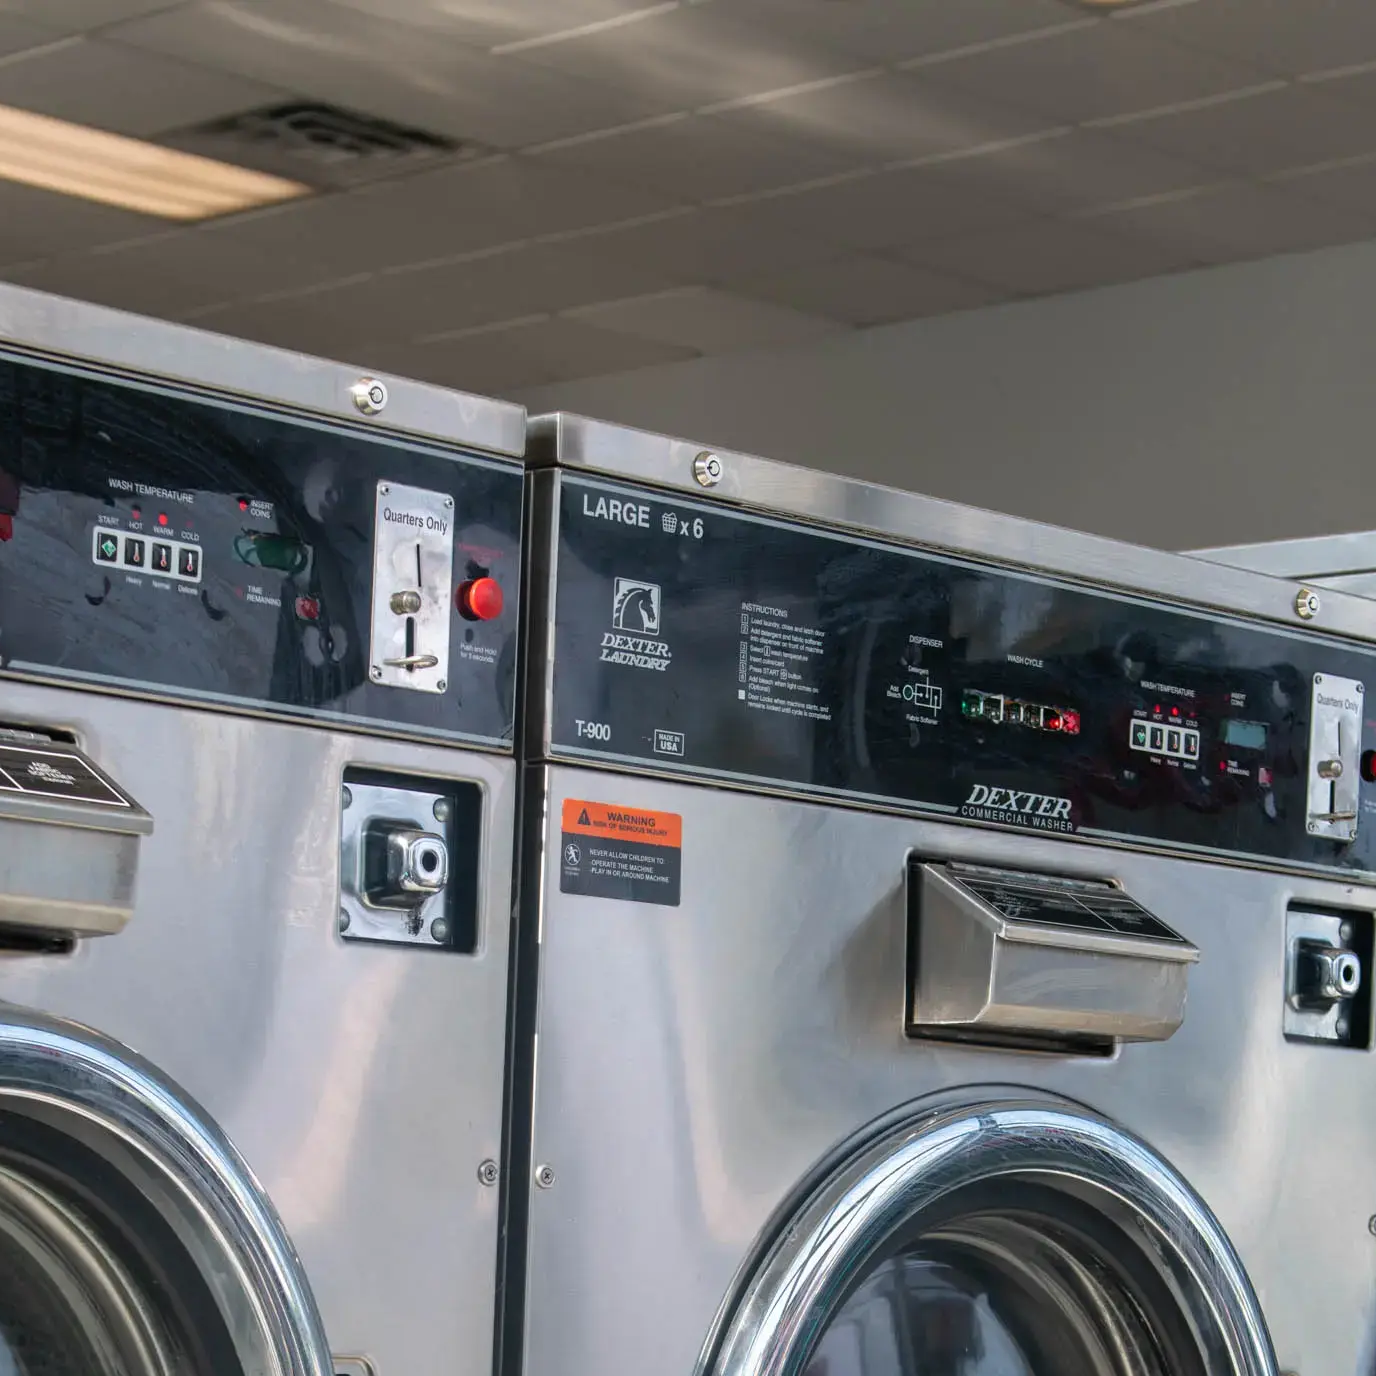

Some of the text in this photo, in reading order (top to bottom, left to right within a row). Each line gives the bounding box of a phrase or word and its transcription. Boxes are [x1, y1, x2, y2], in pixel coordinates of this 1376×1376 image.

[109, 478, 194, 504] WASH TEMPERATURE
[251, 500, 274, 511] INSERT
[251, 508, 271, 519] COINS
[384, 507, 448, 535] Quarters Only
[582, 494, 704, 539] LARGE x 6
[98, 515, 200, 542] START HOT WARM COLD
[247, 584, 263, 595] TIME
[246, 593, 281, 607] REMAINING
[742, 602, 788, 618] INSTRUCTIONS
[909, 634, 943, 648] DISPENSER
[599, 649, 671, 671] LAUNDRY
[1007, 654, 1044, 668] WASH CYCLE
[1317, 693, 1359, 713] Quarters Only
[575, 719, 611, 741] T-900
[659, 733, 674, 741] MADE
[660, 741, 678, 751] USA
[965, 784, 1072, 819] DEXTER
[607, 812, 656, 828] WARNING
[961, 805, 1073, 832] COMMERCIAL WASHER
[589, 849, 608, 857] NEVER
[609, 852, 628, 860] ALLOW
[629, 853, 656, 863] CHILDREN
[618, 862, 629, 870] THE
[629, 864, 653, 873] MACHINE
[613, 869, 621, 877] OR
[622, 871, 644, 880] AROUND
[645, 873, 669, 883] MACHINE
